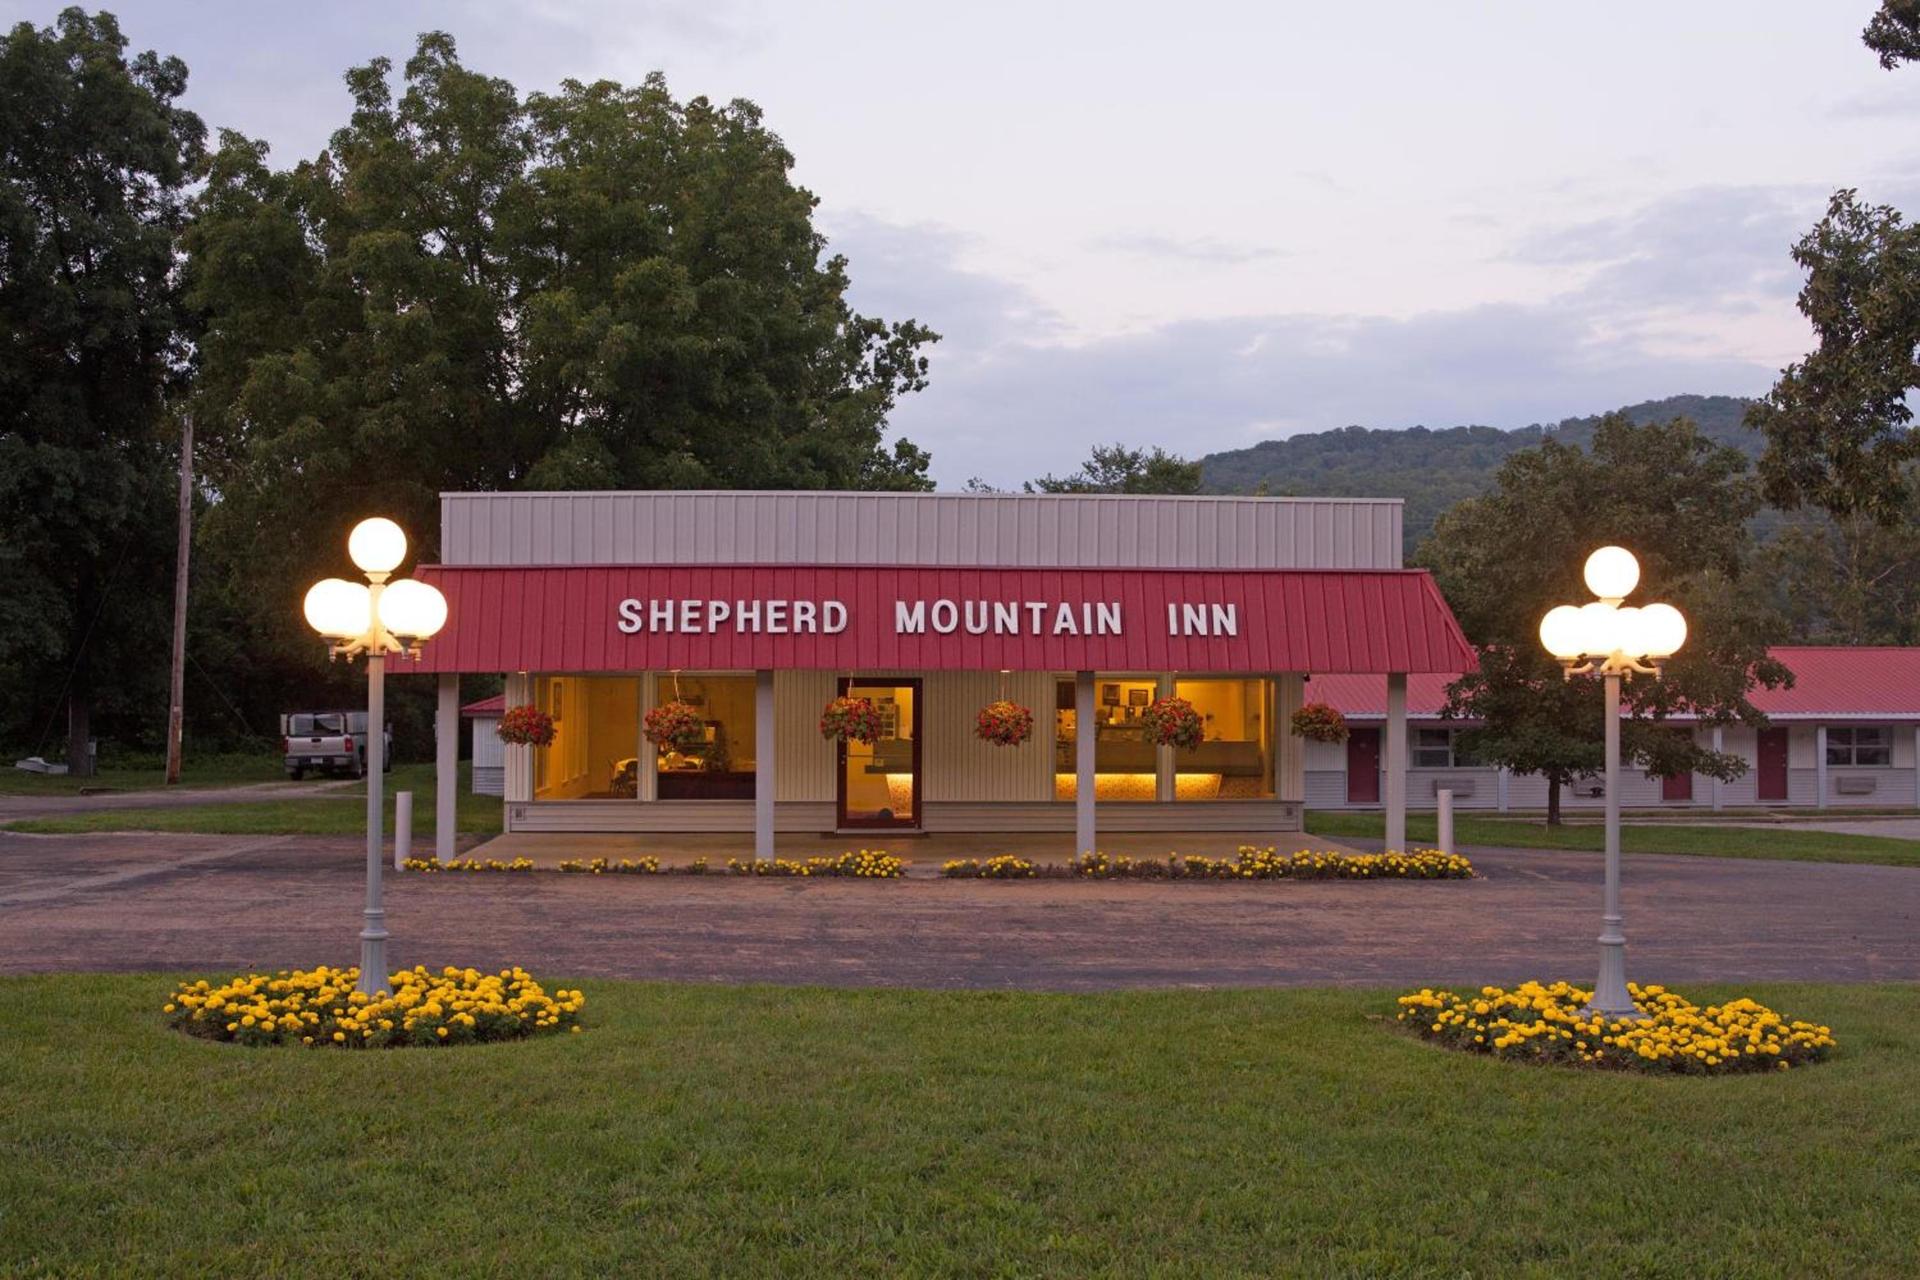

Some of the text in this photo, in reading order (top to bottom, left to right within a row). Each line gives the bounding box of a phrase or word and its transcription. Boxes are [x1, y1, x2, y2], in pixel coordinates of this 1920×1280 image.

[617, 599, 1237, 636] SHEPHERD MOUNTAIN INN
